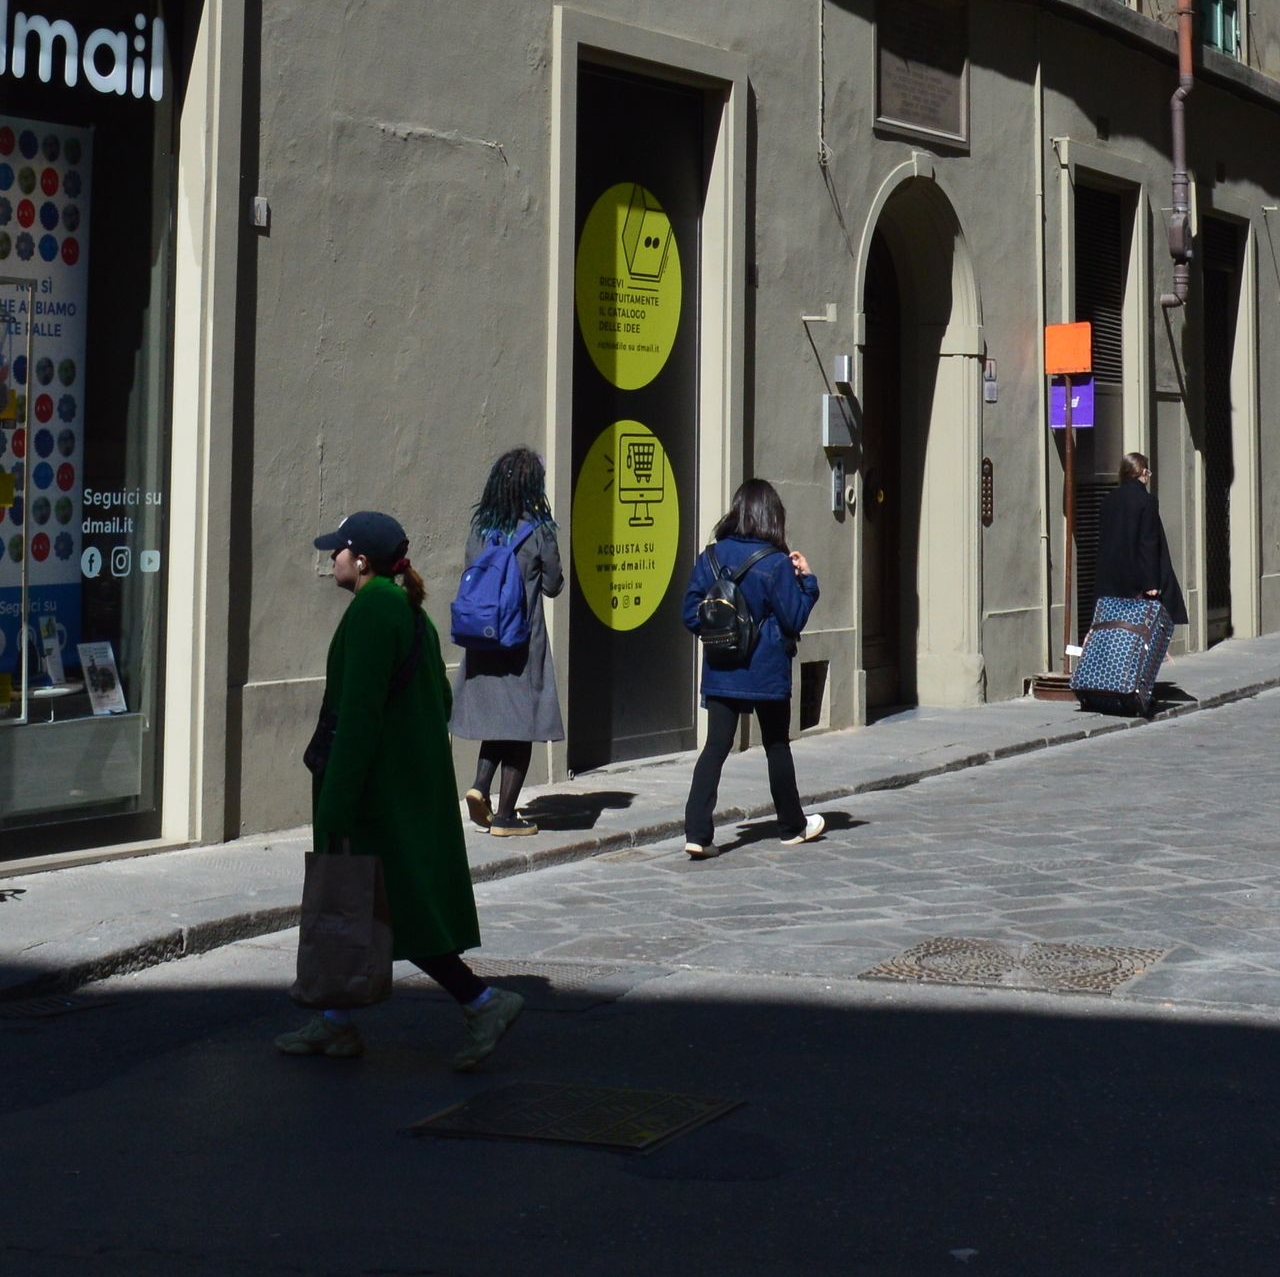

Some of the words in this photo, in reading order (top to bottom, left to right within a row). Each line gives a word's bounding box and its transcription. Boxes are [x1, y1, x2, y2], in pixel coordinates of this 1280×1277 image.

[599, 291, 660, 307] GRATUITAMENTE
[18, 299, 77, 317] ABIAMO
[607, 307, 646, 320] CATALOGO
[599, 321, 622, 333] DELLE
[623, 323, 641, 334] IDEE
[83, 487, 140, 510] Seguici
[145, 492, 162, 506] su
[81, 516, 134, 534] dmail.it
[597, 543, 640, 556] ACQUISTA
[644, 543, 655, 553] SU
[596, 559, 656, 573] www.dmail.it
[609, 581, 634, 593] Seguici
[0, 598, 41, 617] Segici
[43, 600, 57, 612] su
